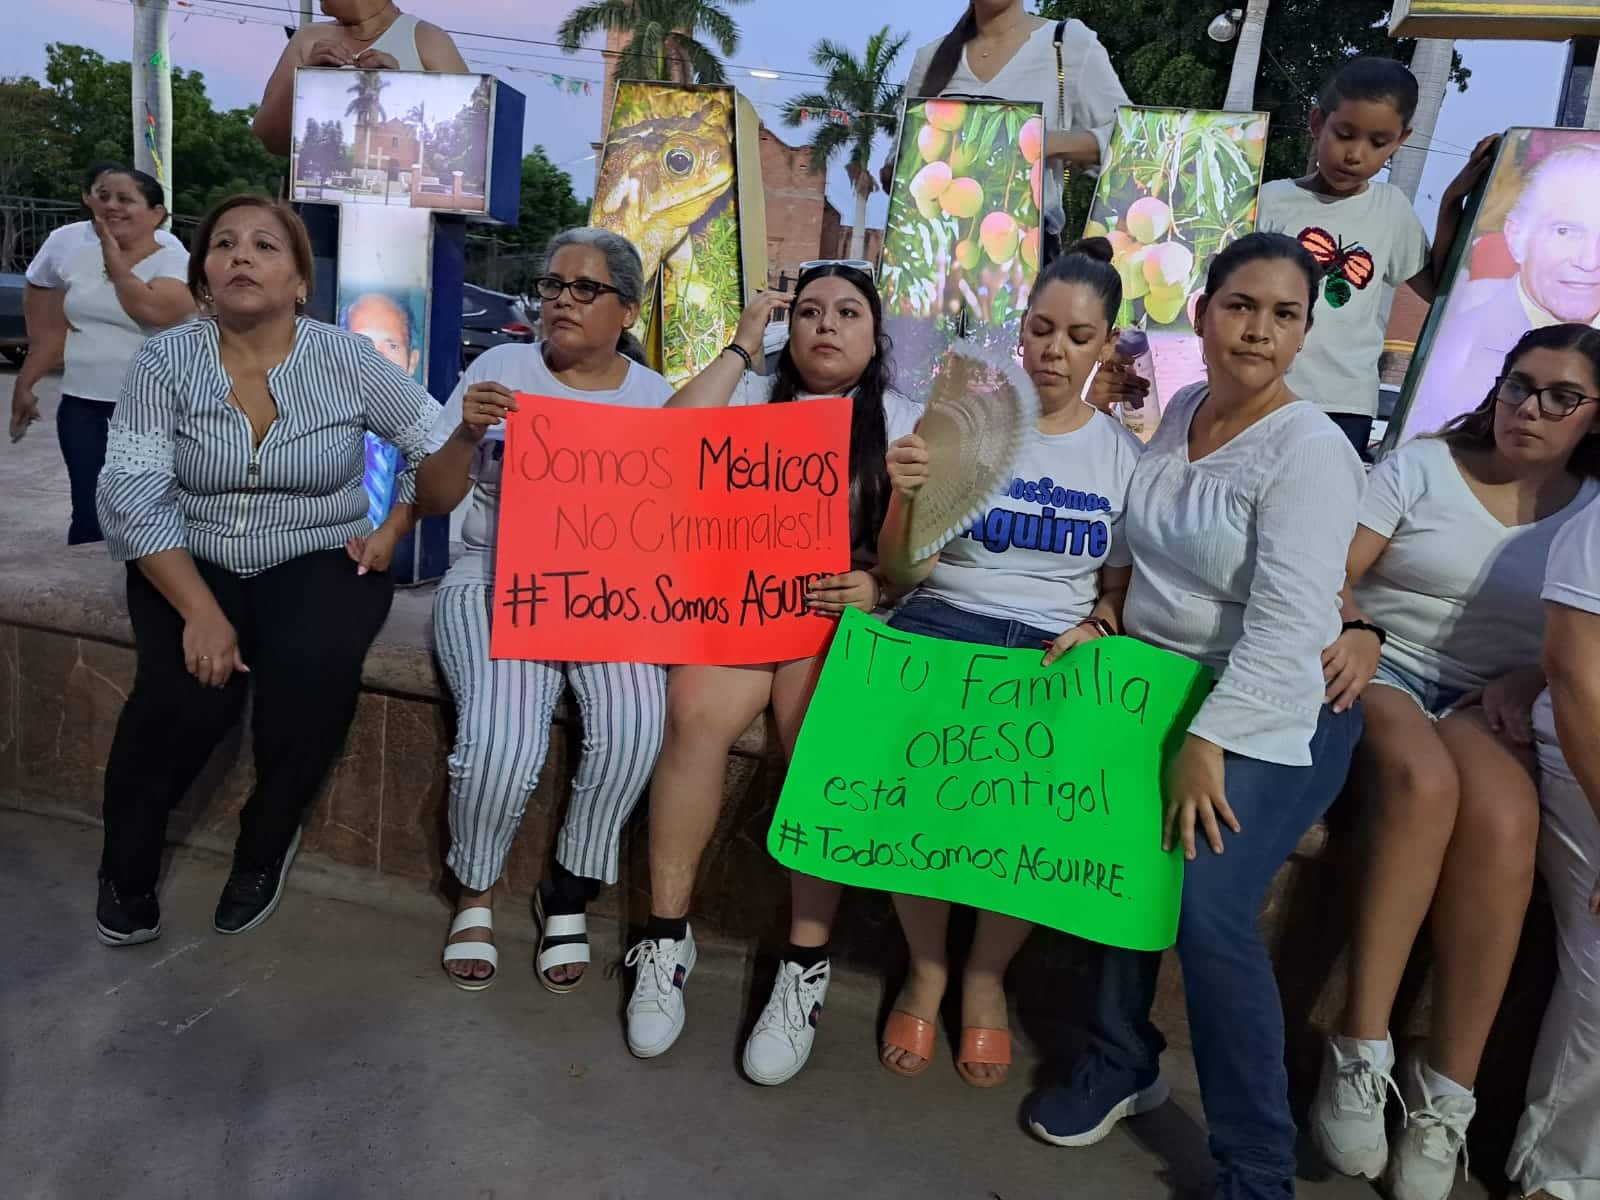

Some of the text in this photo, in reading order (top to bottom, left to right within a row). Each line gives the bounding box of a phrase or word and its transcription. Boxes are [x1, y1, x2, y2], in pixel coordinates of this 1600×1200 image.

[698, 435, 840, 497] Médicos
[554, 503, 618, 551] No
[961, 647, 1151, 725] Familia
[905, 721, 1055, 769] OBESO
[823, 776, 906, 812] está
